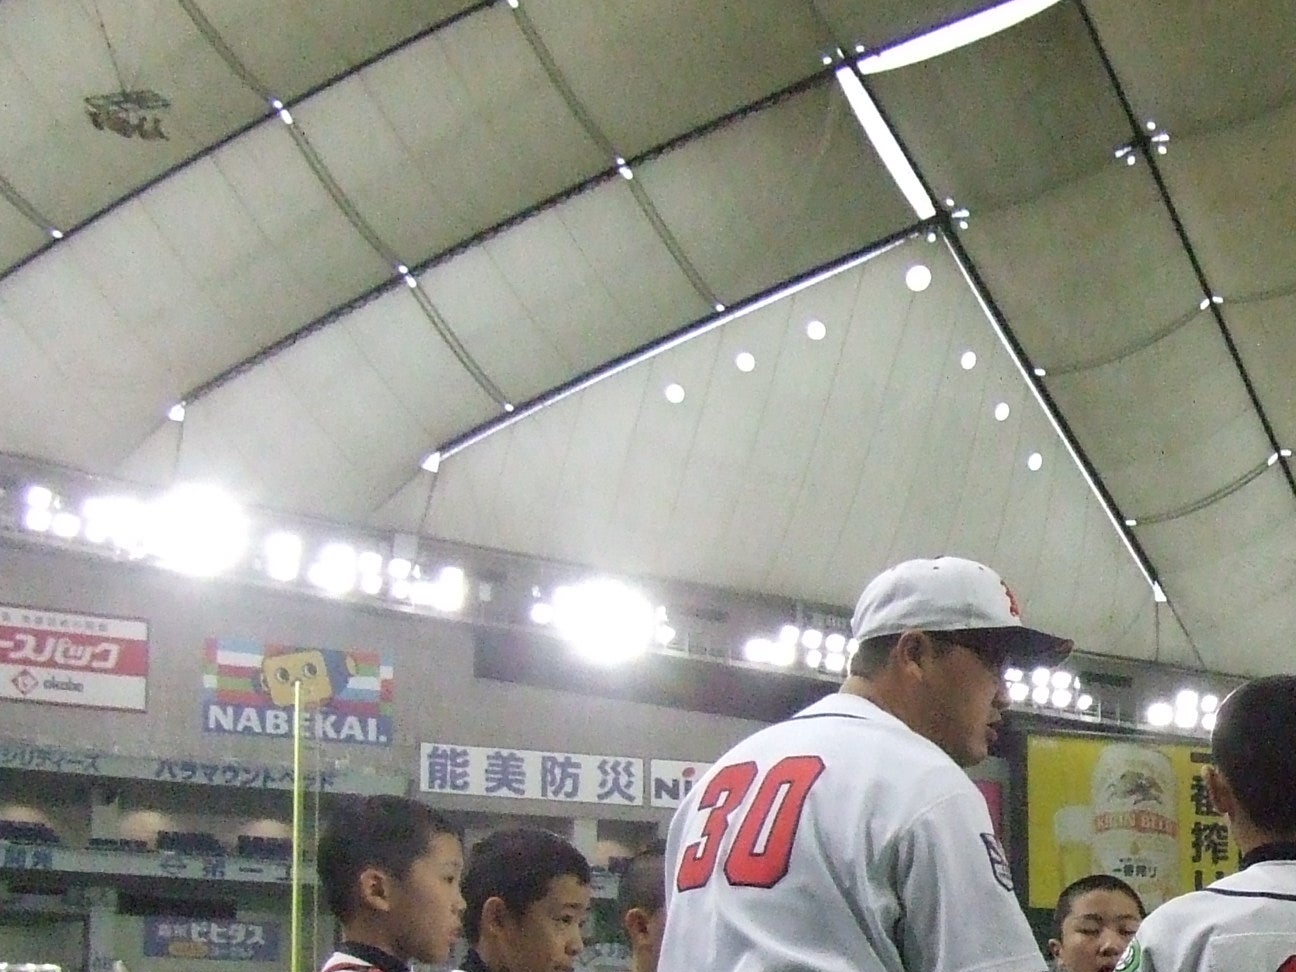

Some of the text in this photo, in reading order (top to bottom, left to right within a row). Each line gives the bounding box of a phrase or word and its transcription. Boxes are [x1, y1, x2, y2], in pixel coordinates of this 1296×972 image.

[427, 745, 635, 802] 能美防災
[676, 754, 827, 892] 30
